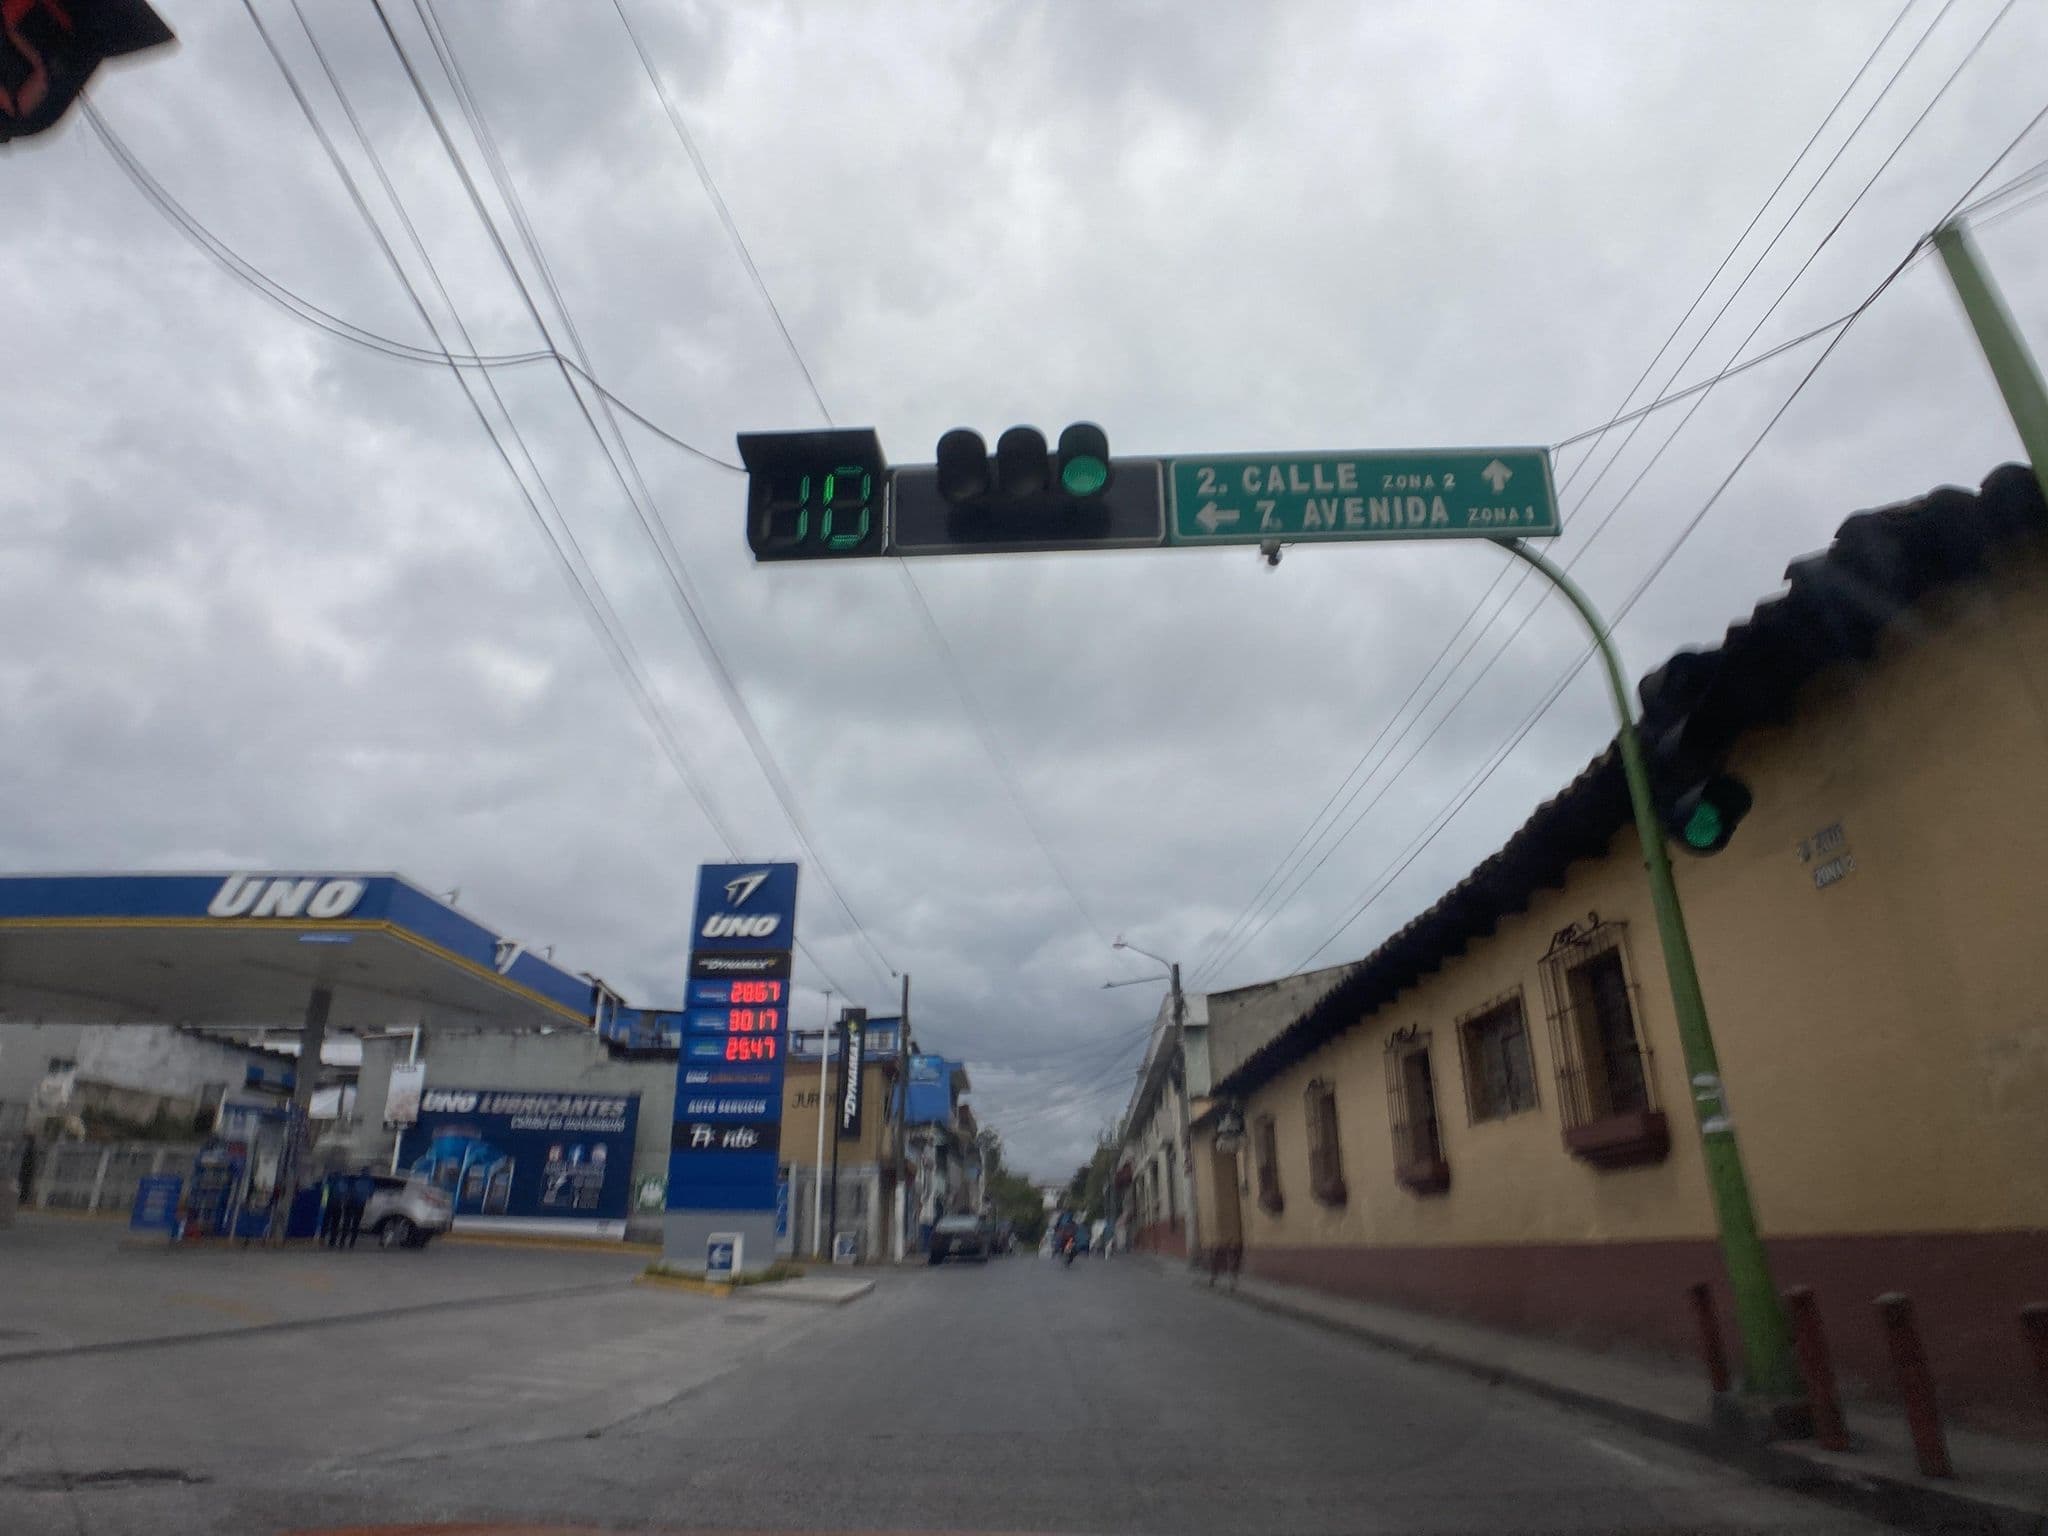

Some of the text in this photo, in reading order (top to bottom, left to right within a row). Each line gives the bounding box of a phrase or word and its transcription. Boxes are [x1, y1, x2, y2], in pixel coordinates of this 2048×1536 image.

[1197, 463, 1358, 495] 2. CALLE
[1383, 473, 1456, 491] ZONA 2
[797, 465, 871, 550] 10
[1303, 496, 1449, 528] AVENIDA
[1468, 508, 1519, 523] ZONA
[207, 871, 367, 918] UNO
[702, 912, 779, 938] UNO
[421, 1092, 478, 1113] UNO
